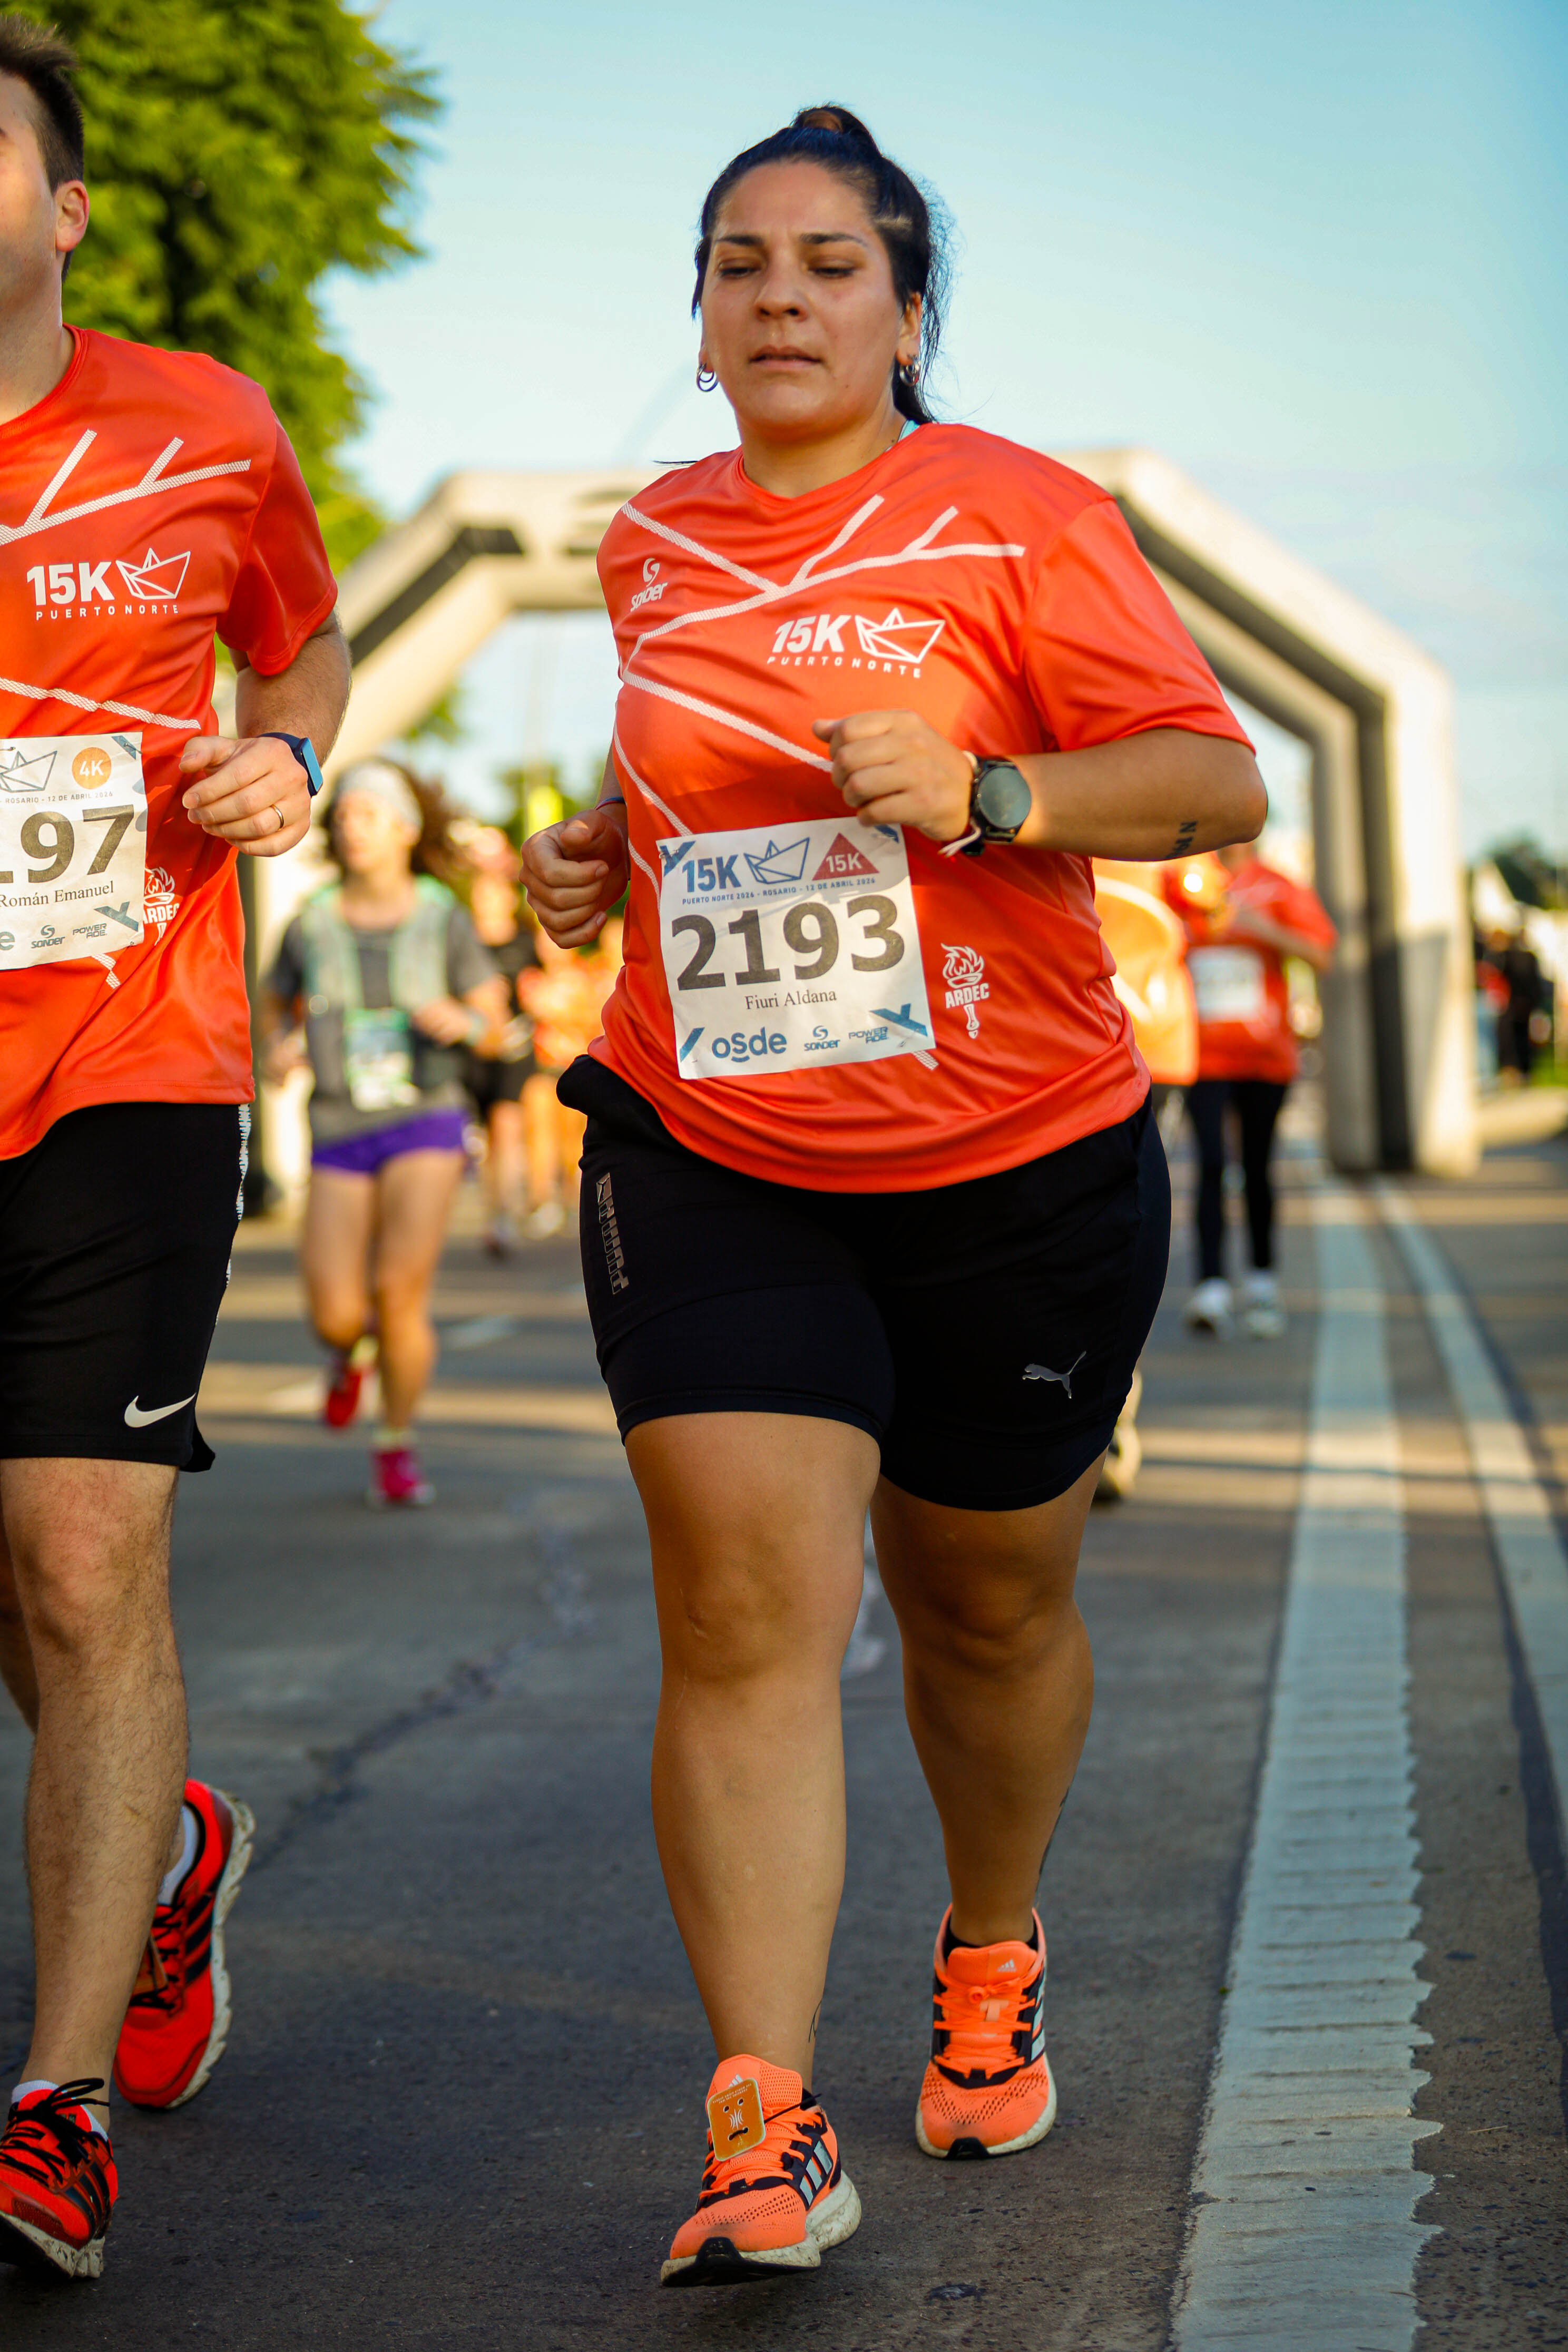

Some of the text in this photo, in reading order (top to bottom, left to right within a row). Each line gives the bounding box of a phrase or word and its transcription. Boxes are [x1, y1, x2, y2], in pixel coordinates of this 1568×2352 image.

[27, 562, 115, 606] 15K
[36, 604, 179, 621] PUERTO NORTE
[772, 614, 852, 653] 15K
[767, 656, 921, 679] PUERTO NORTE
[79, 759, 104, 777] 4K
[0, 804, 134, 884] 97
[682, 854, 742, 893] 15K
[826, 851, 863, 873] 15K
[0, 880, 114, 907] Román Emanuel
[682, 896, 709, 905] PUERTO
[762, 886, 797, 896] ROSARIO
[73, 923, 107, 936] POWER
[671, 894, 905, 991] 2193
[744, 989, 837, 1010] Fiuri Aldana
[945, 983, 989, 1009] ARDEC
[711, 1026, 787, 1060] osde
[849, 1026, 888, 1039] POWER
[599, 1196, 630, 1295] PUMA
